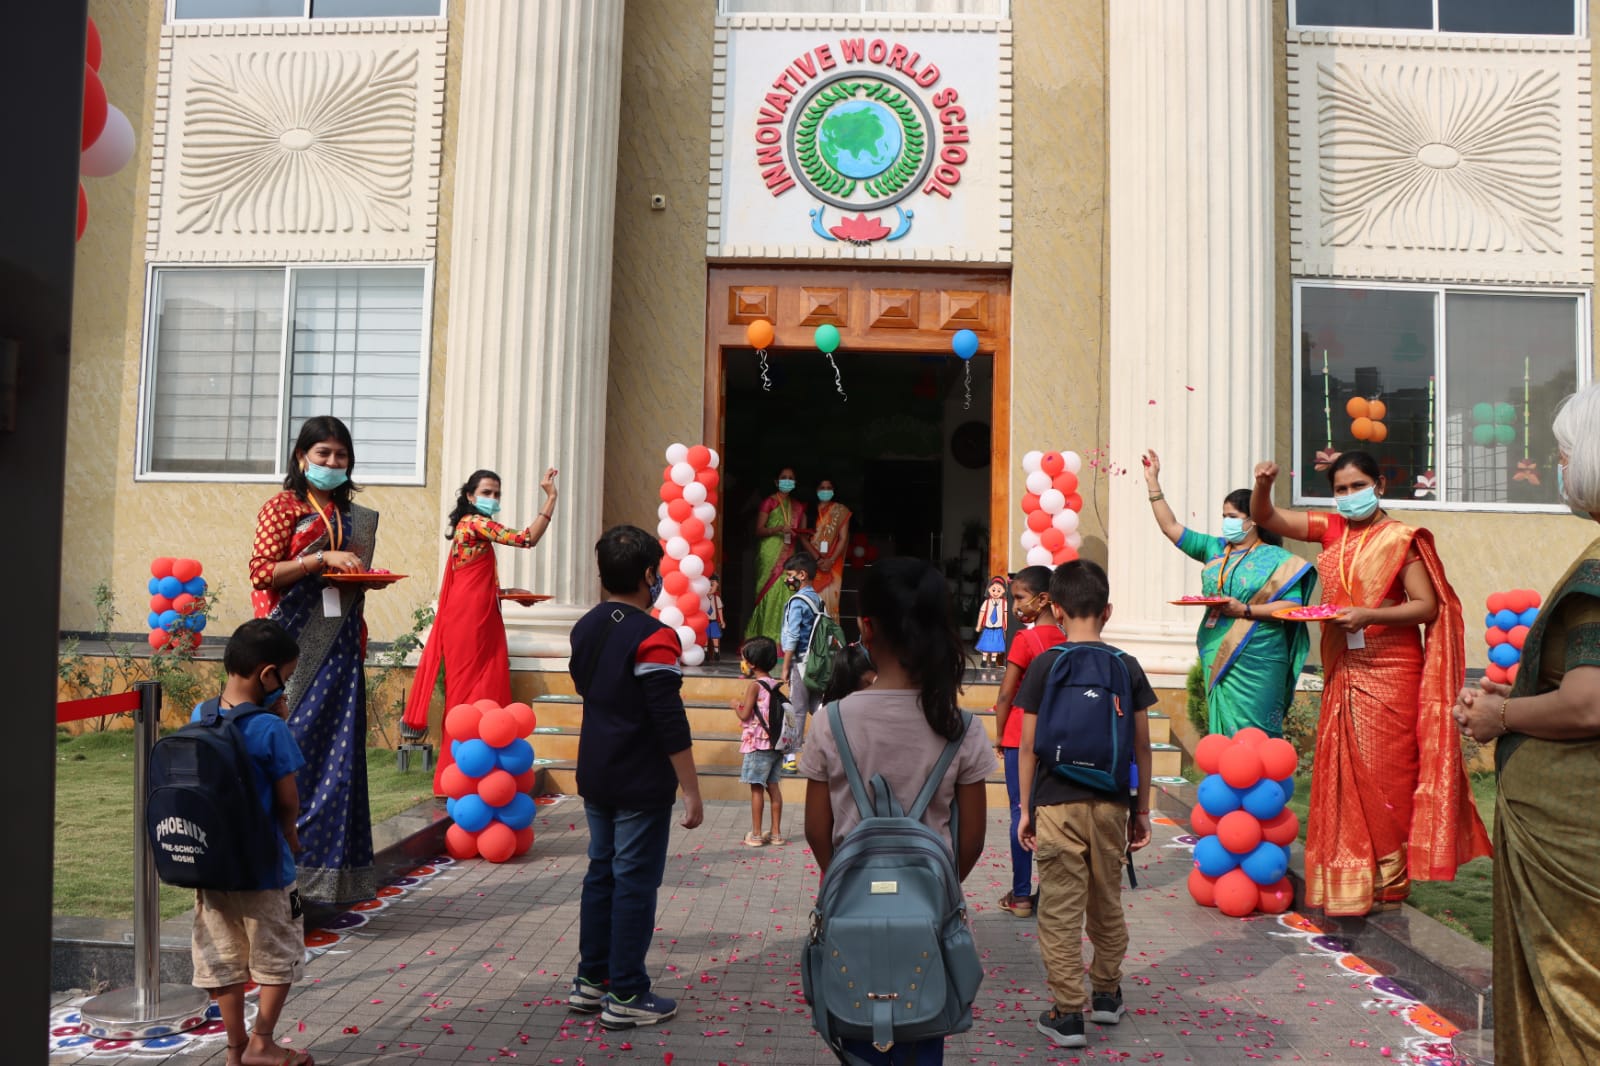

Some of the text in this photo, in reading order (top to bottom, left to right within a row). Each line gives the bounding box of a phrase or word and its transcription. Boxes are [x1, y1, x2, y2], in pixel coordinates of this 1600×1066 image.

[755, 38, 969, 199] INNOVATIVE WORLD SCHOOL
[156, 816, 208, 848] PHOENIX
[161, 842, 205, 855] PRE-SCHOOL
